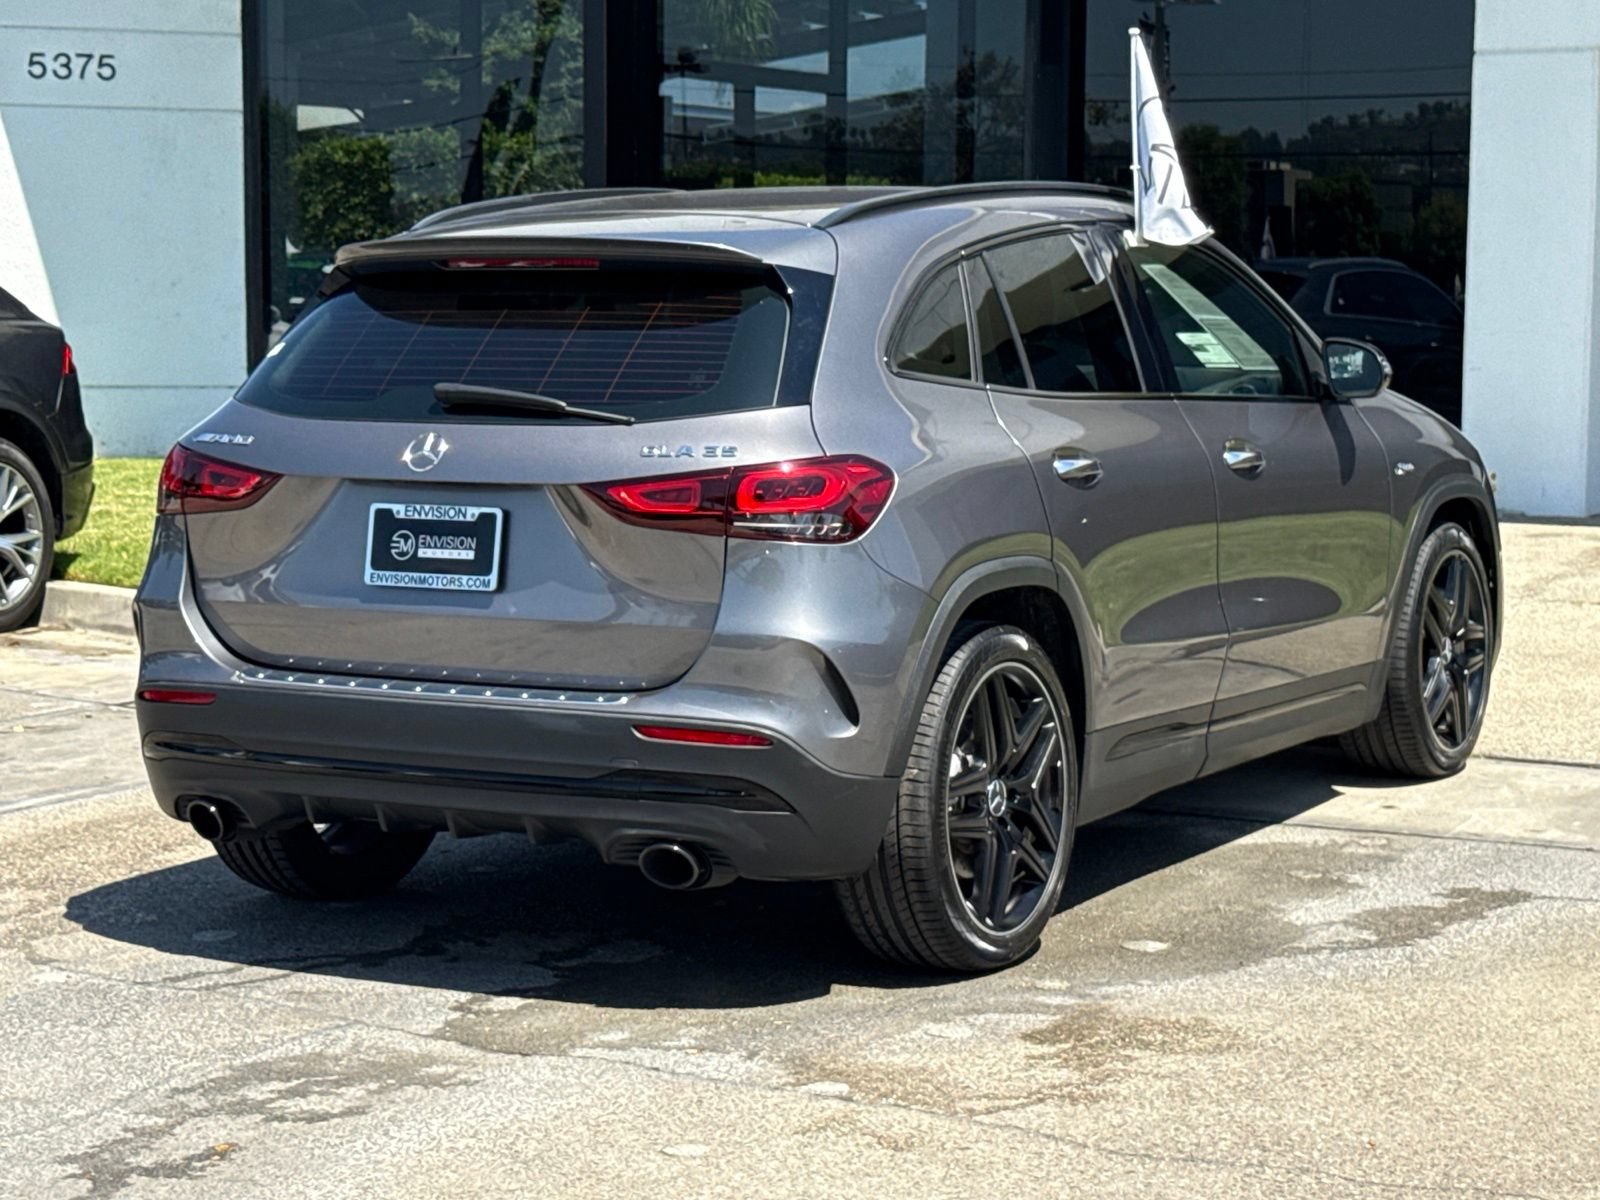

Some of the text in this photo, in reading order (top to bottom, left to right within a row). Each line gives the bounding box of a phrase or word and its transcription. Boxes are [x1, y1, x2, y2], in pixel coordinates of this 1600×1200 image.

[27, 52, 117, 81] 5375
[640, 445, 738, 458] GLA 35
[404, 505, 468, 520] ENVISION
[418, 534, 477, 550] ENVISION
[369, 572, 491, 589] ENVISIONMOTORS.COM
